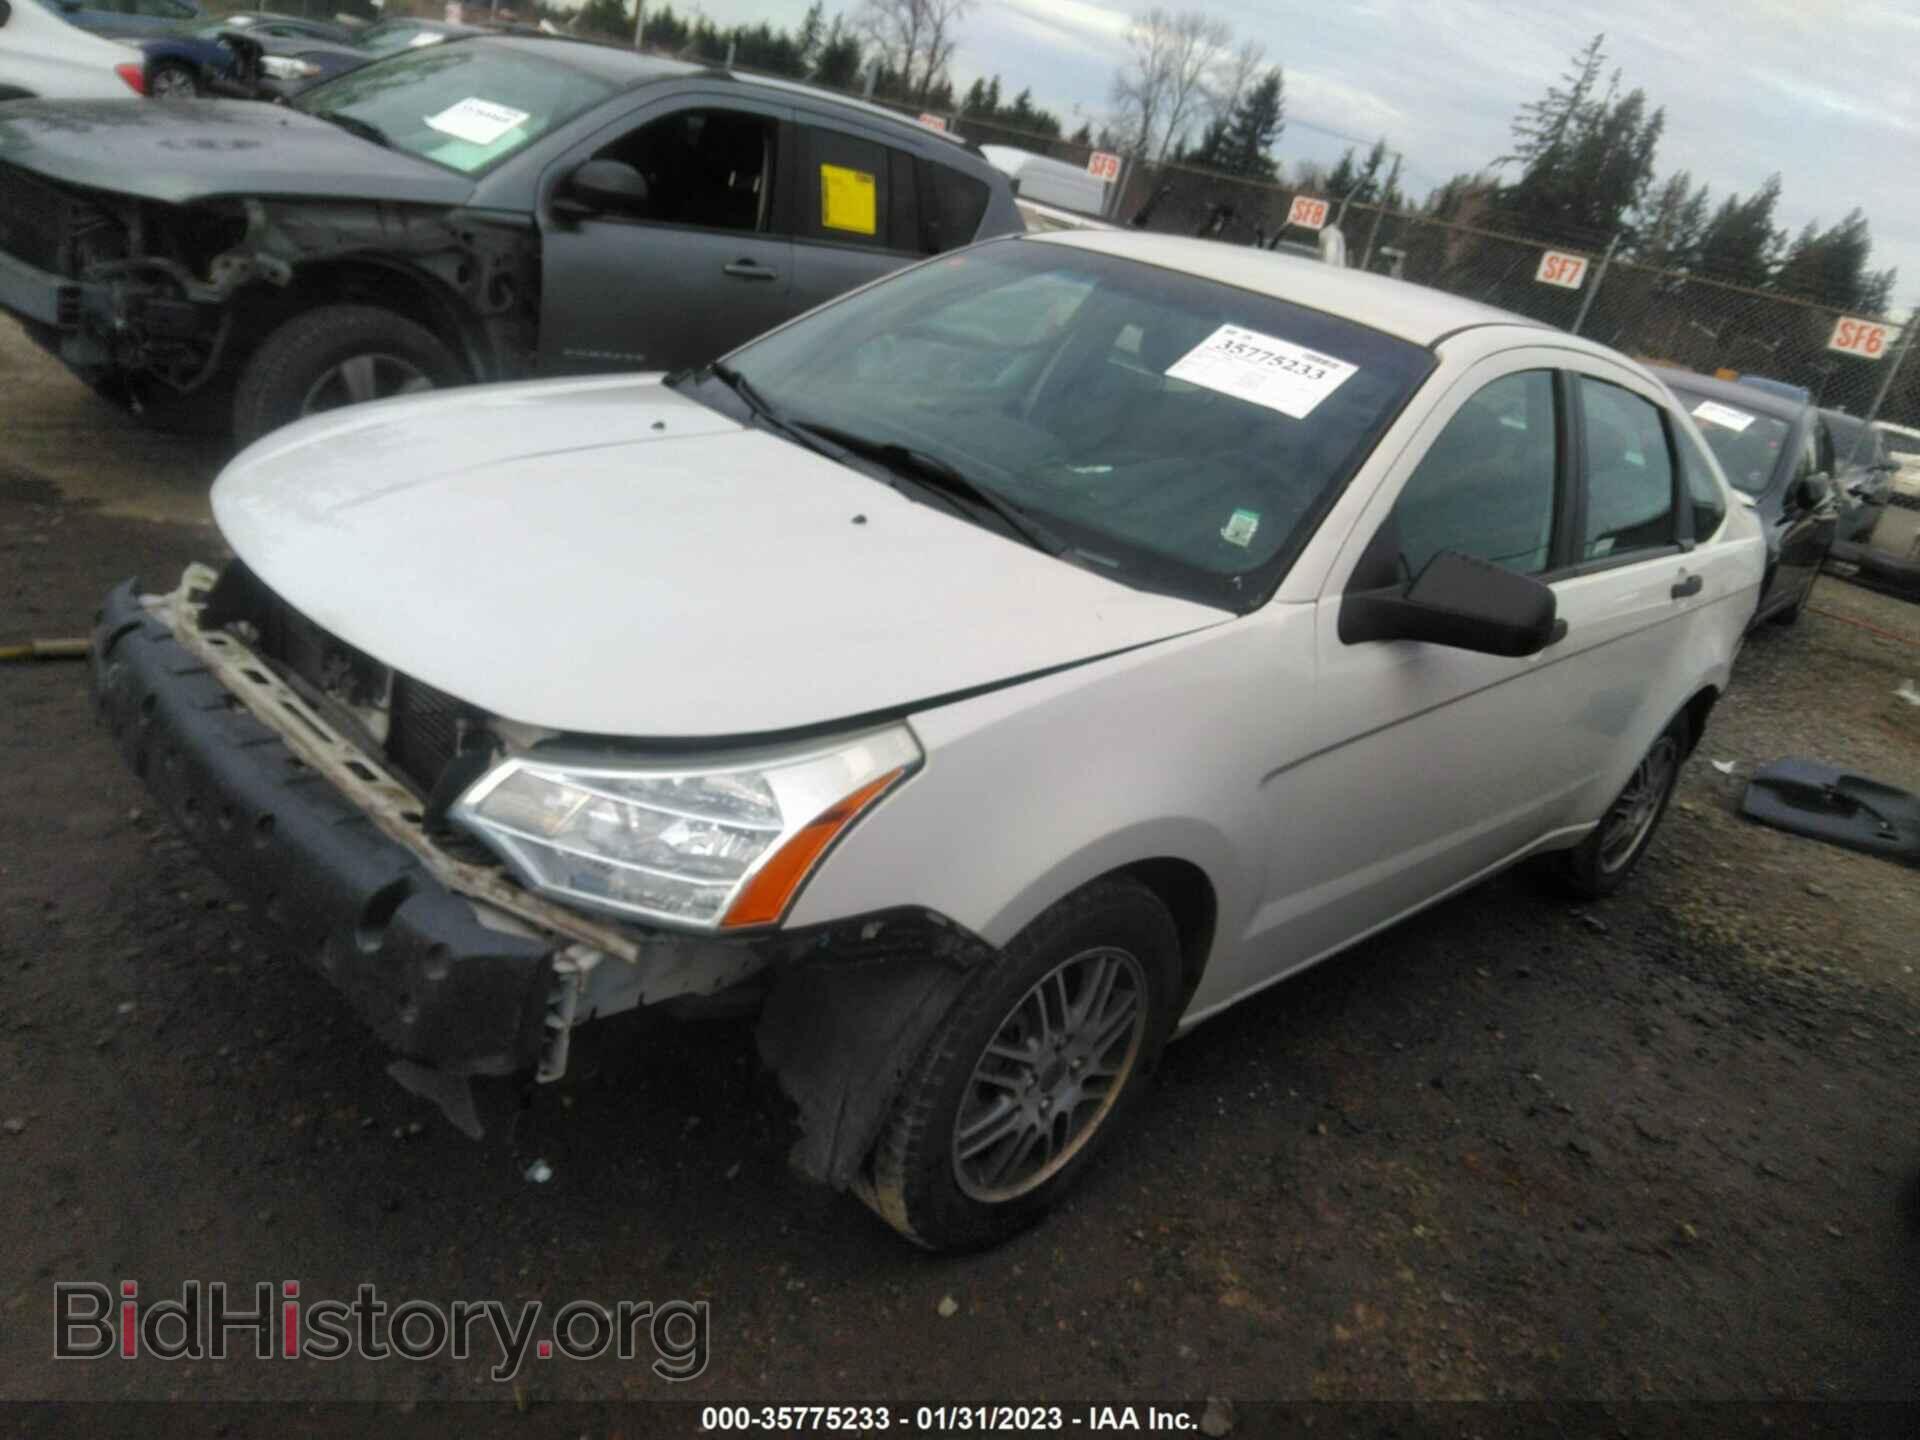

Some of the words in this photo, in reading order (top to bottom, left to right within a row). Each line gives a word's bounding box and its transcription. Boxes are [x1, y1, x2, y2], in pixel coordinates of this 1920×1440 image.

[1089, 154, 1117, 177] SF9
[1293, 198, 1325, 226] SF8
[1542, 255, 1583, 285] SF7
[1836, 319, 1887, 355] SF6
[1216, 339, 1326, 381] 35775233
